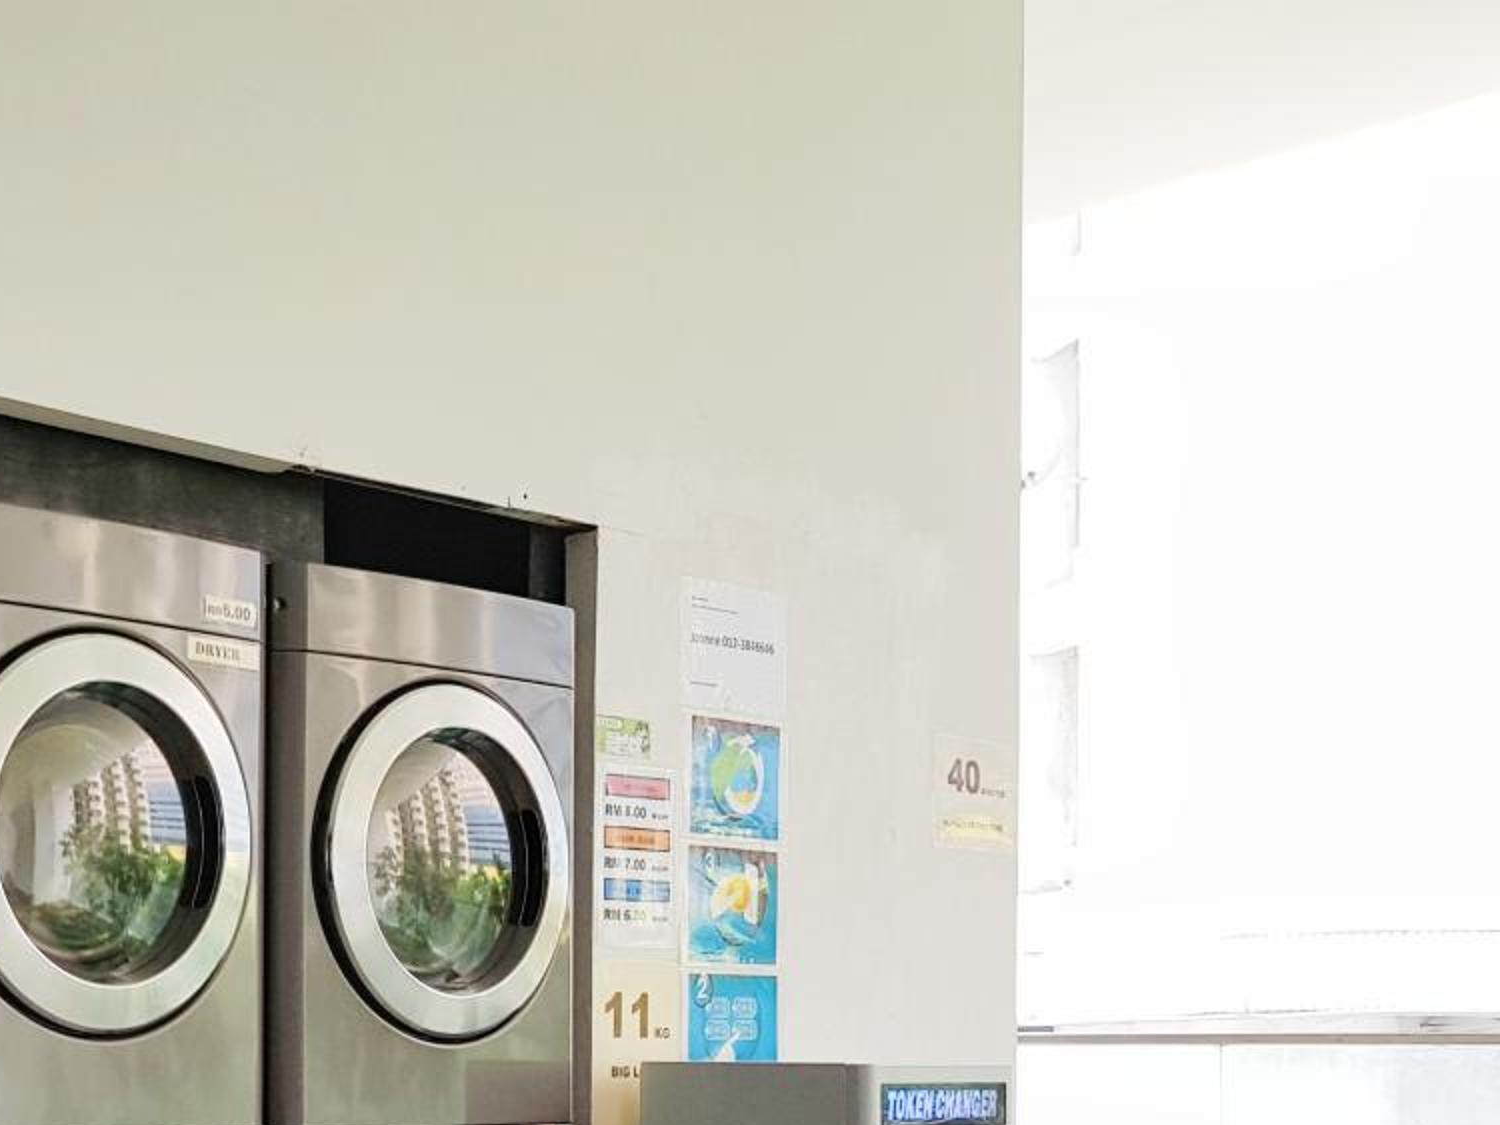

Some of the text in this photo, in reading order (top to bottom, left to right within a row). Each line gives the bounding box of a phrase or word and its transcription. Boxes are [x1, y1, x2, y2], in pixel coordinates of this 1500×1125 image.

[947, 757, 981, 794] 40
[604, 991, 671, 1040] 11 KG
[886, 1088, 998, 1121] TOKEN CHANGER
